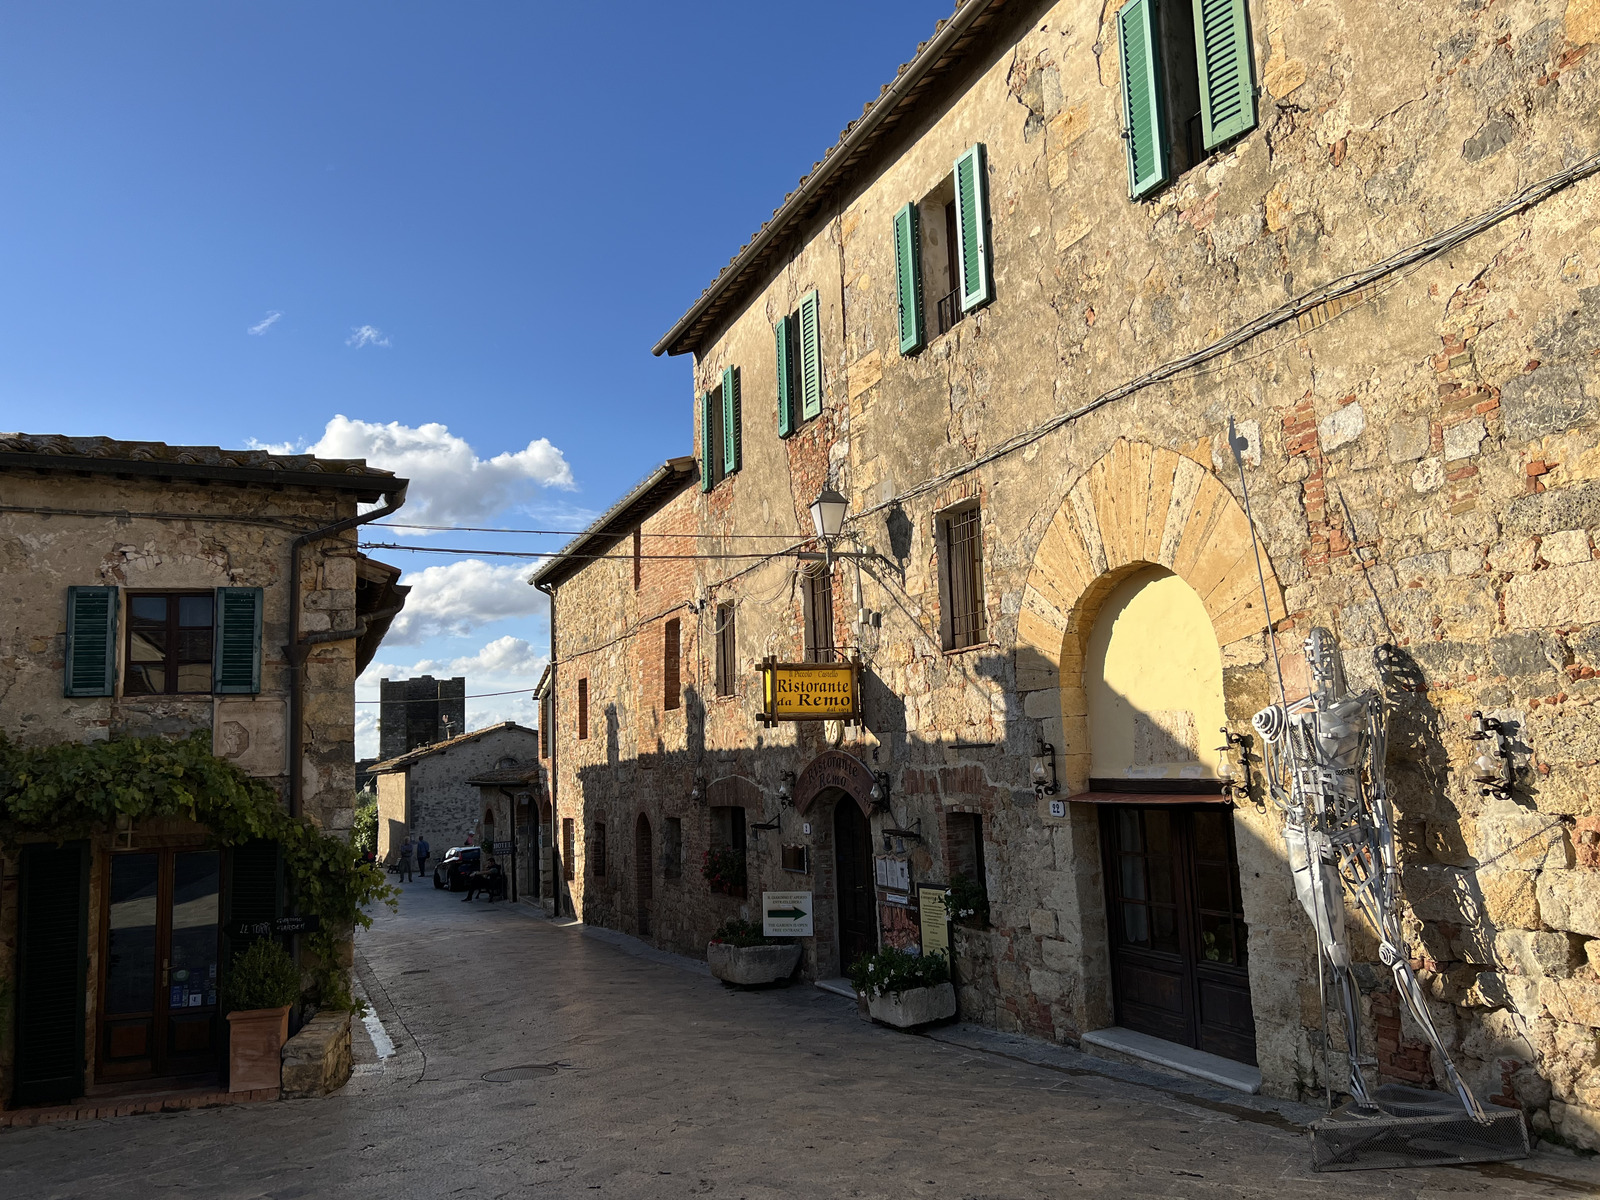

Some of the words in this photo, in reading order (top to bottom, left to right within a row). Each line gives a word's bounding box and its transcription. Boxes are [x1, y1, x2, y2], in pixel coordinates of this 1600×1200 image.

[794, 670, 813, 678] Piccolo
[817, 670, 839, 678] Castello
[776, 678, 849, 693] Ristorante
[776, 697, 792, 706] da
[797, 693, 851, 706] Remo
[807, 756, 858, 785] Ristorante
[818, 772, 847, 788] Remo
[1052, 803, 1060, 813] 22
